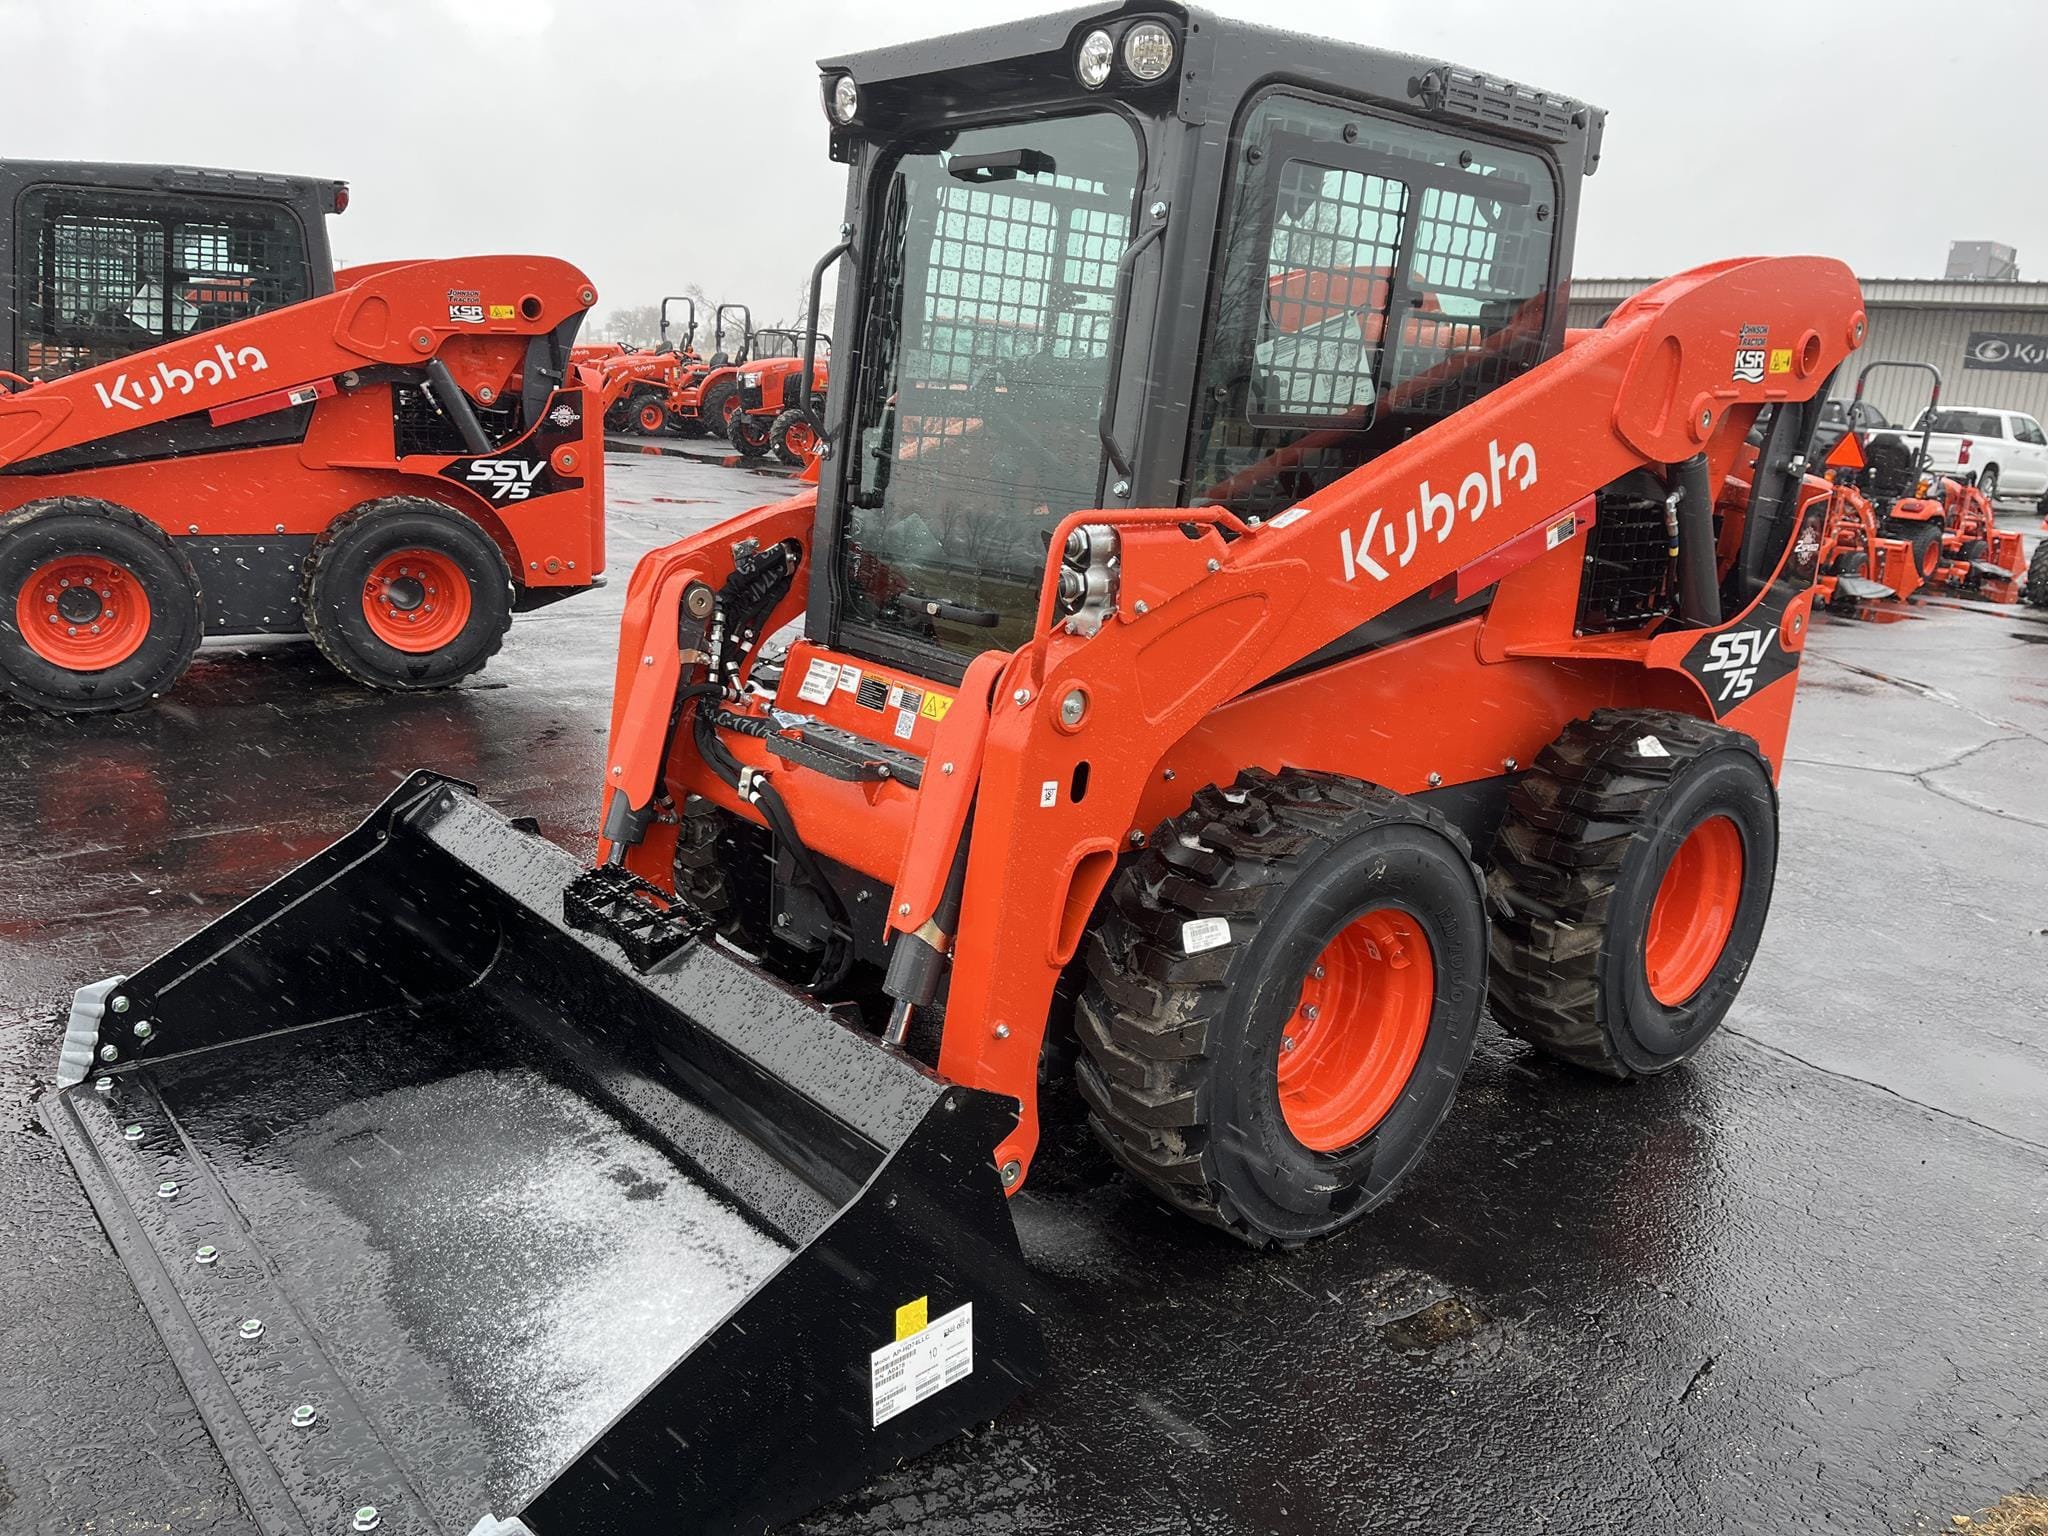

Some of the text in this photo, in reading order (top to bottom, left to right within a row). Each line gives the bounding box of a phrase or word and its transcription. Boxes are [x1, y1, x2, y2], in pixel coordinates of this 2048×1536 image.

[448, 288, 480, 297] JOHNSON
[448, 295, 480, 303] TRACTOR
[449, 305, 483, 316] KSR
[1739, 323, 1769, 334] JOHNSON
[1739, 335, 1767, 346] TRACTOR
[1734, 350, 1766, 369] KSR
[2014, 343, 2048, 364] Ku
[94, 343, 269, 411] Kubota
[466, 459, 548, 481] SSV
[491, 481, 532, 499] 75
[1339, 438, 1538, 582] Kubota
[1702, 627, 1778, 673] SSV
[1717, 666, 1758, 701] 75
